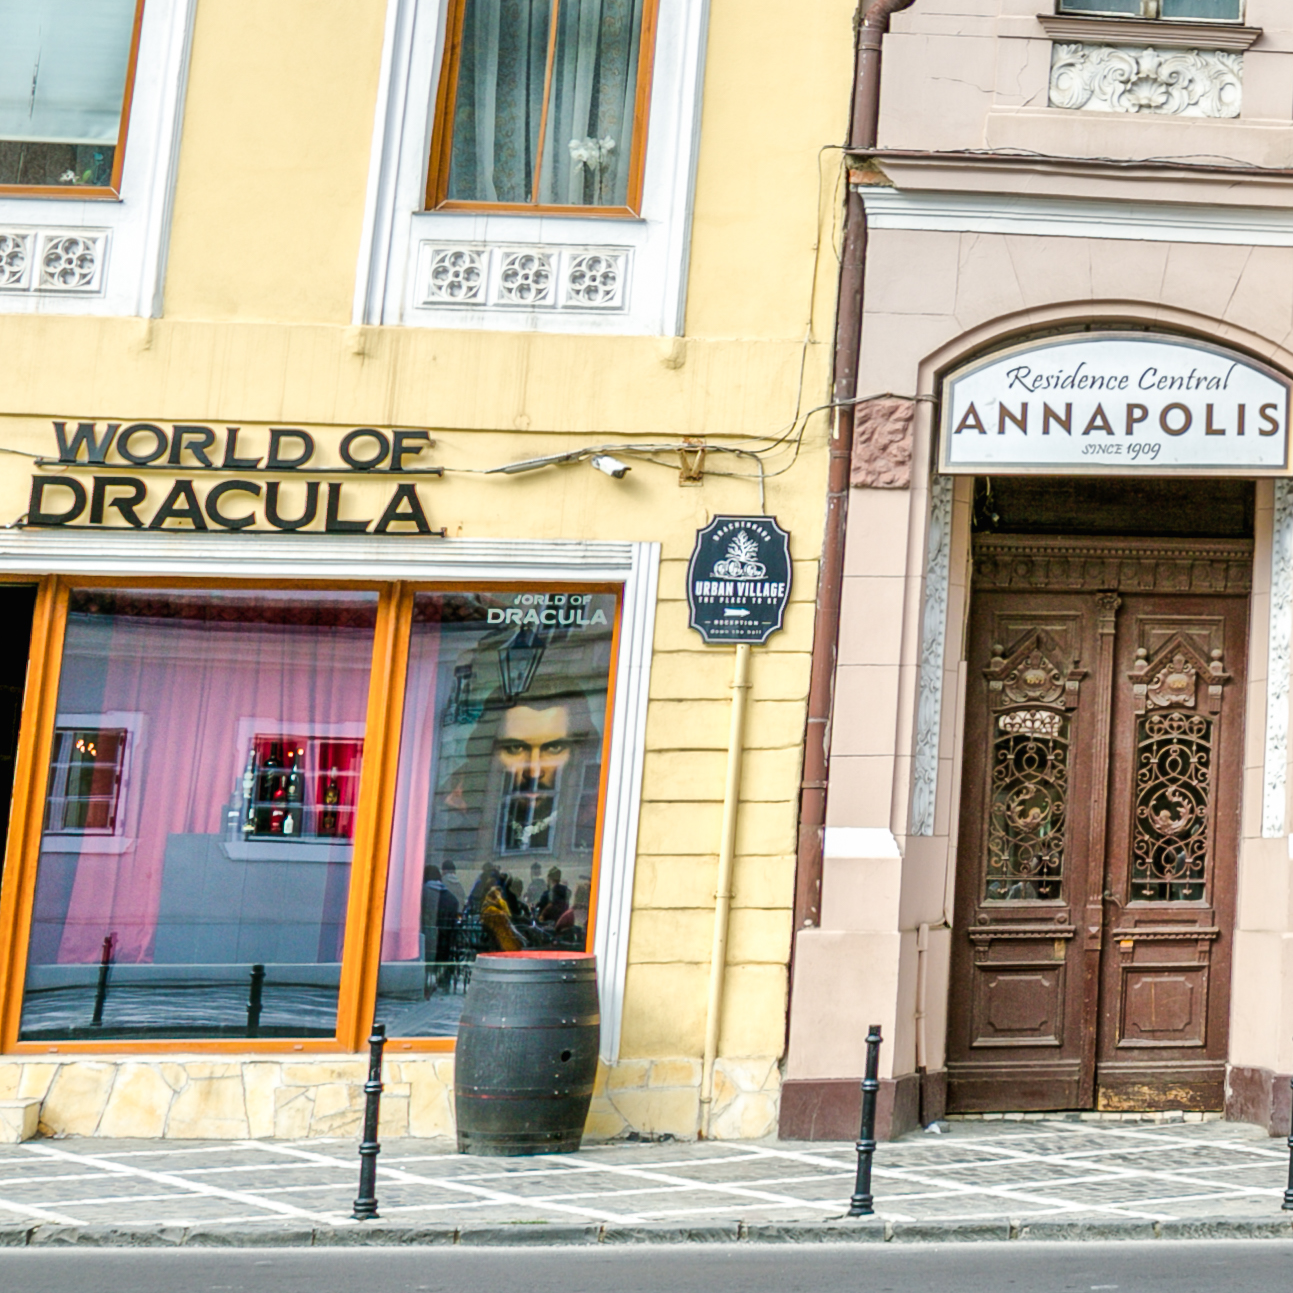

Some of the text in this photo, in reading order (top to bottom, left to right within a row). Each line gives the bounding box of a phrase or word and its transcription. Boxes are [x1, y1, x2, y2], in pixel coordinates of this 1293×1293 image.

[1006, 362, 1238, 392] Residence Central
[952, 401, 1280, 437] ANNAPOLIS
[52, 421, 431, 471] WORLD OF
[1081, 443, 1161, 460] SINCE 1909
[27, 474, 432, 533] DRACULA
[570, 595, 593, 605] OF
[695, 581, 785, 597] URBAN VILLAGE
[487, 608, 608, 625] DRACULA
